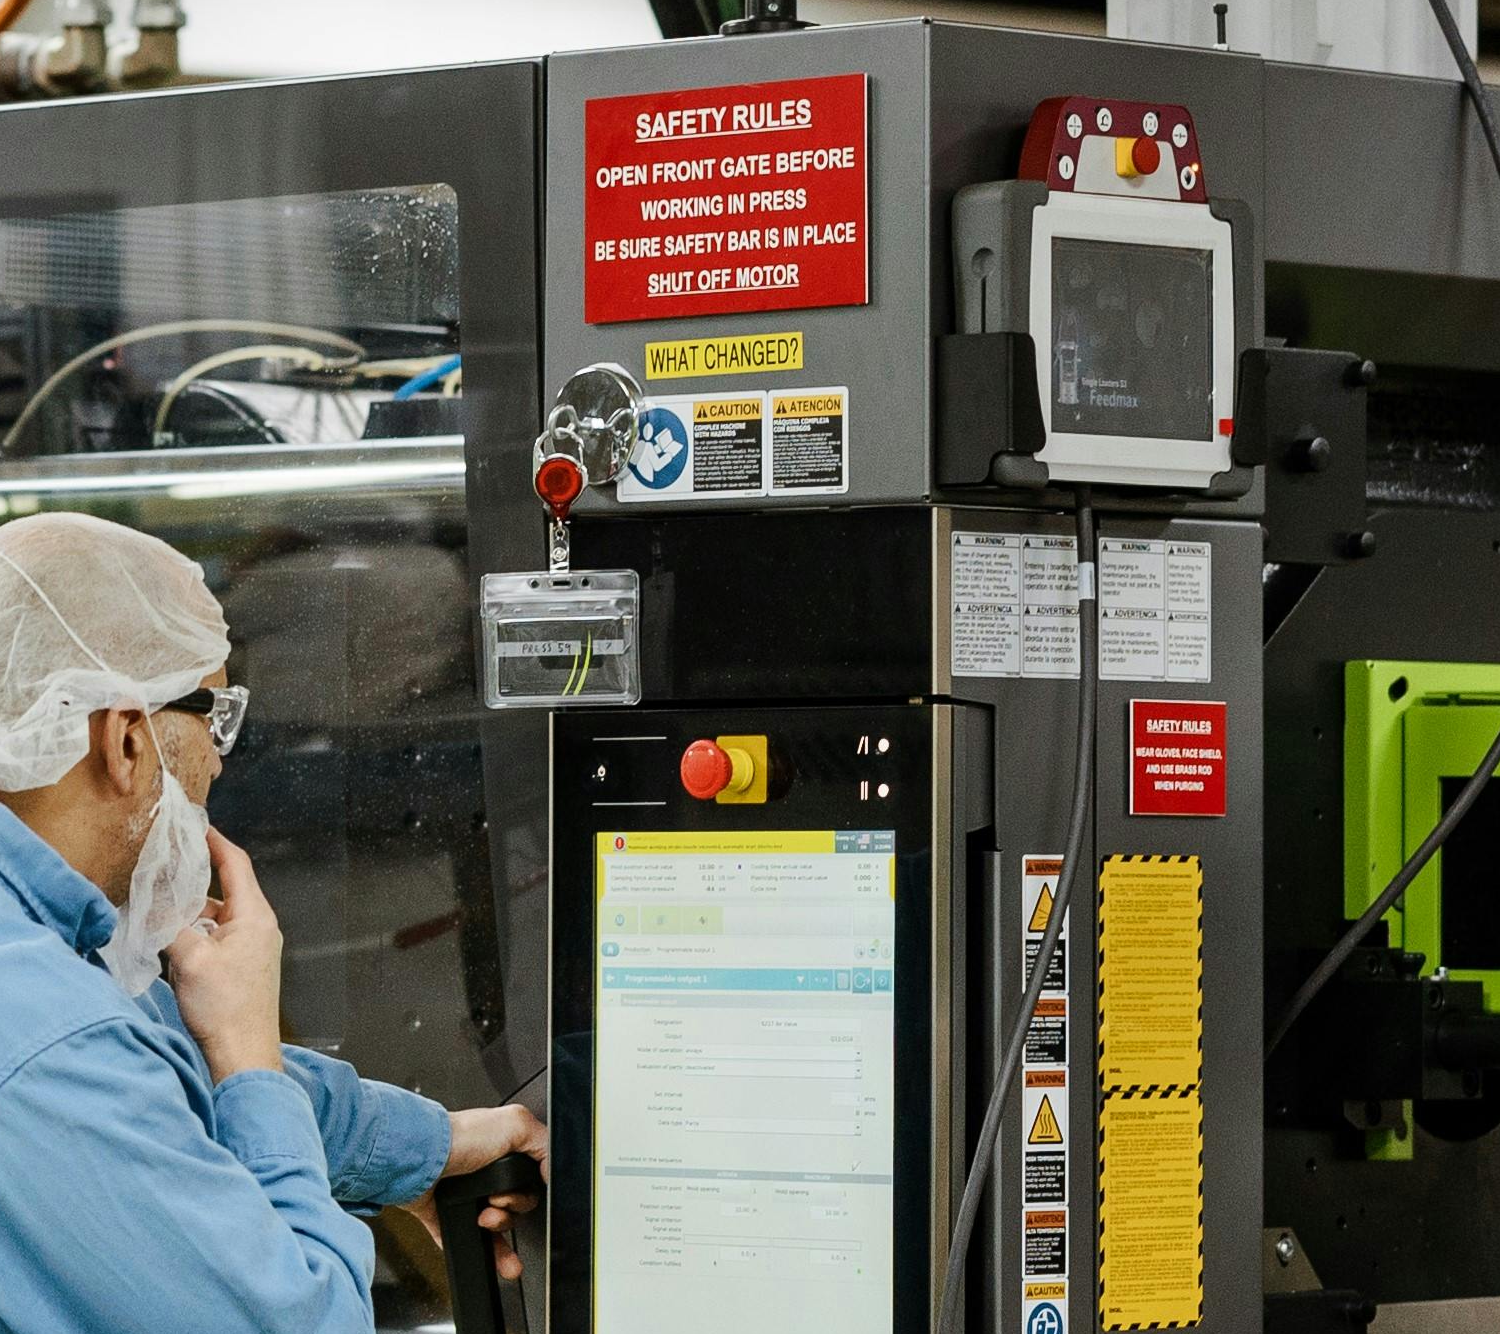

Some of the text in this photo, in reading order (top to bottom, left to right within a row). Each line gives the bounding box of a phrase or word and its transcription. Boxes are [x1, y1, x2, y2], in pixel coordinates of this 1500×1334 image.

[636, 99, 811, 139] SAFETY RULES
[596, 147, 854, 188] OPEN FRONT GATE BEFORE
[641, 188, 806, 220] WORKING IN PRESS
[596, 222, 856, 261] BE SURE SAFETY BAR IS IN PLACE
[648, 264, 798, 293] SHUT OFF MOTOR
[650, 337, 799, 374] WHAT CHANGED?
[1090, 390, 1138, 408] Feedmax
[710, 403, 759, 416] CAUTION
[790, 399, 841, 412] ATENCIÓN
[975, 537, 1005, 545] WARNING
[1044, 539, 1074, 547] WARNING
[1122, 543, 1151, 551] WARNING
[1177, 547, 1205, 555] WARNING
[967, 604, 1012, 614] ADVERTENCIA
[1114, 610, 1158, 618] ADVERTENCIA
[522, 642, 571, 654] PRESS 59
[1147, 719, 1212, 732] SAFETY RULES
[1136, 747, 1222, 760] WEAR GLOVES, FACE SHIELD,
[1146, 764, 1160, 774] AND
[1161, 765, 1174, 774] USE
[1175, 765, 1197, 774] BRASS
[1154, 781, 1204, 791] WHEN PURGING
[1032, 1074, 1066, 1084] WARNING
[1034, 1216, 1064, 1224] ADVERTENCIA
[1034, 1287, 1064, 1296] CAUTION
